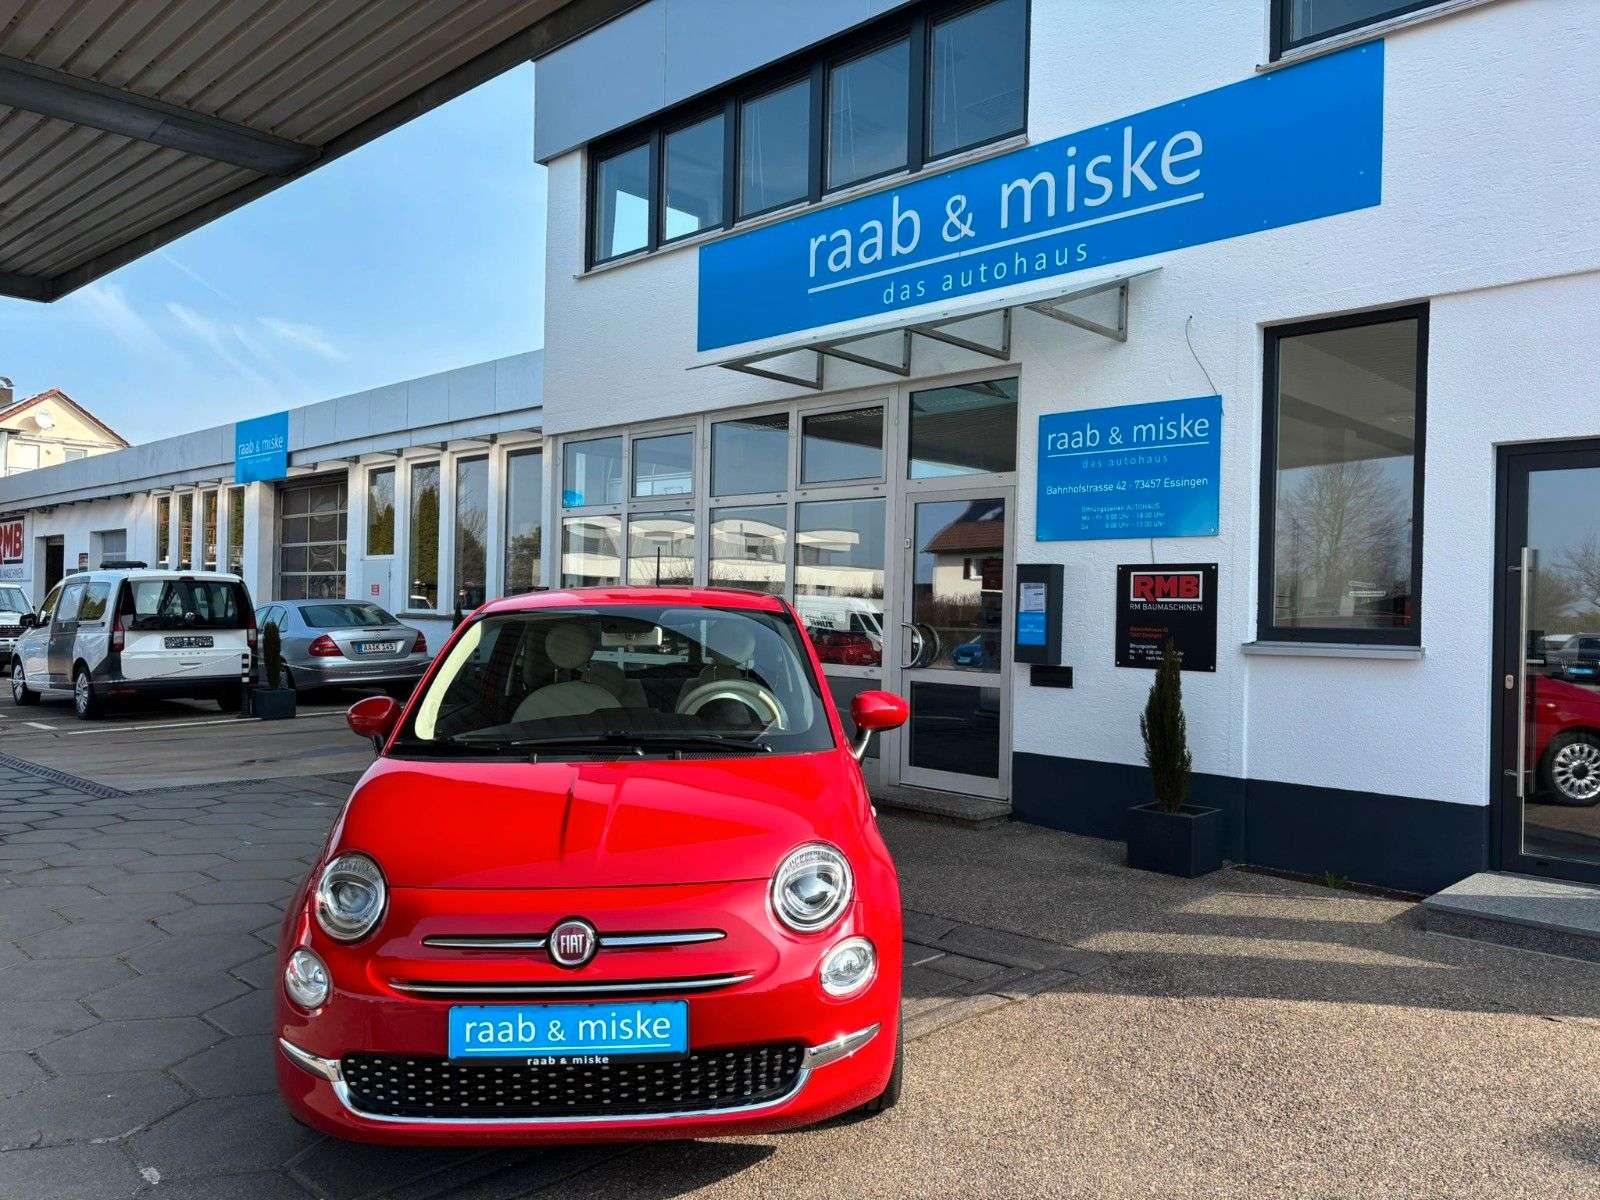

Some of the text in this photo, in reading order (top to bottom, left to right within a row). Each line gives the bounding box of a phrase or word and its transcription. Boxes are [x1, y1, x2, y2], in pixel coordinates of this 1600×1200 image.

[808, 126, 1203, 278] raab & miske
[883, 243, 1088, 305] das autohaus
[1047, 413, 1209, 451] raab & miske
[1082, 455, 1168, 469] das autohaus
[1046, 483, 1114, 495] Bahnhofstrasse
[1116, 481, 1127, 491] 42
[1135, 478, 1161, 489] 73457
[1163, 477, 1209, 488] Essingen
[1134, 575, 1199, 604] RMB
[1142, 603, 1203, 612] BAUMASCHINEN
[560, 933, 585, 954] FIAT
[465, 1009, 671, 1043] raab & miske
[527, 1056, 555, 1065] raab
[572, 1054, 609, 1065] miske
